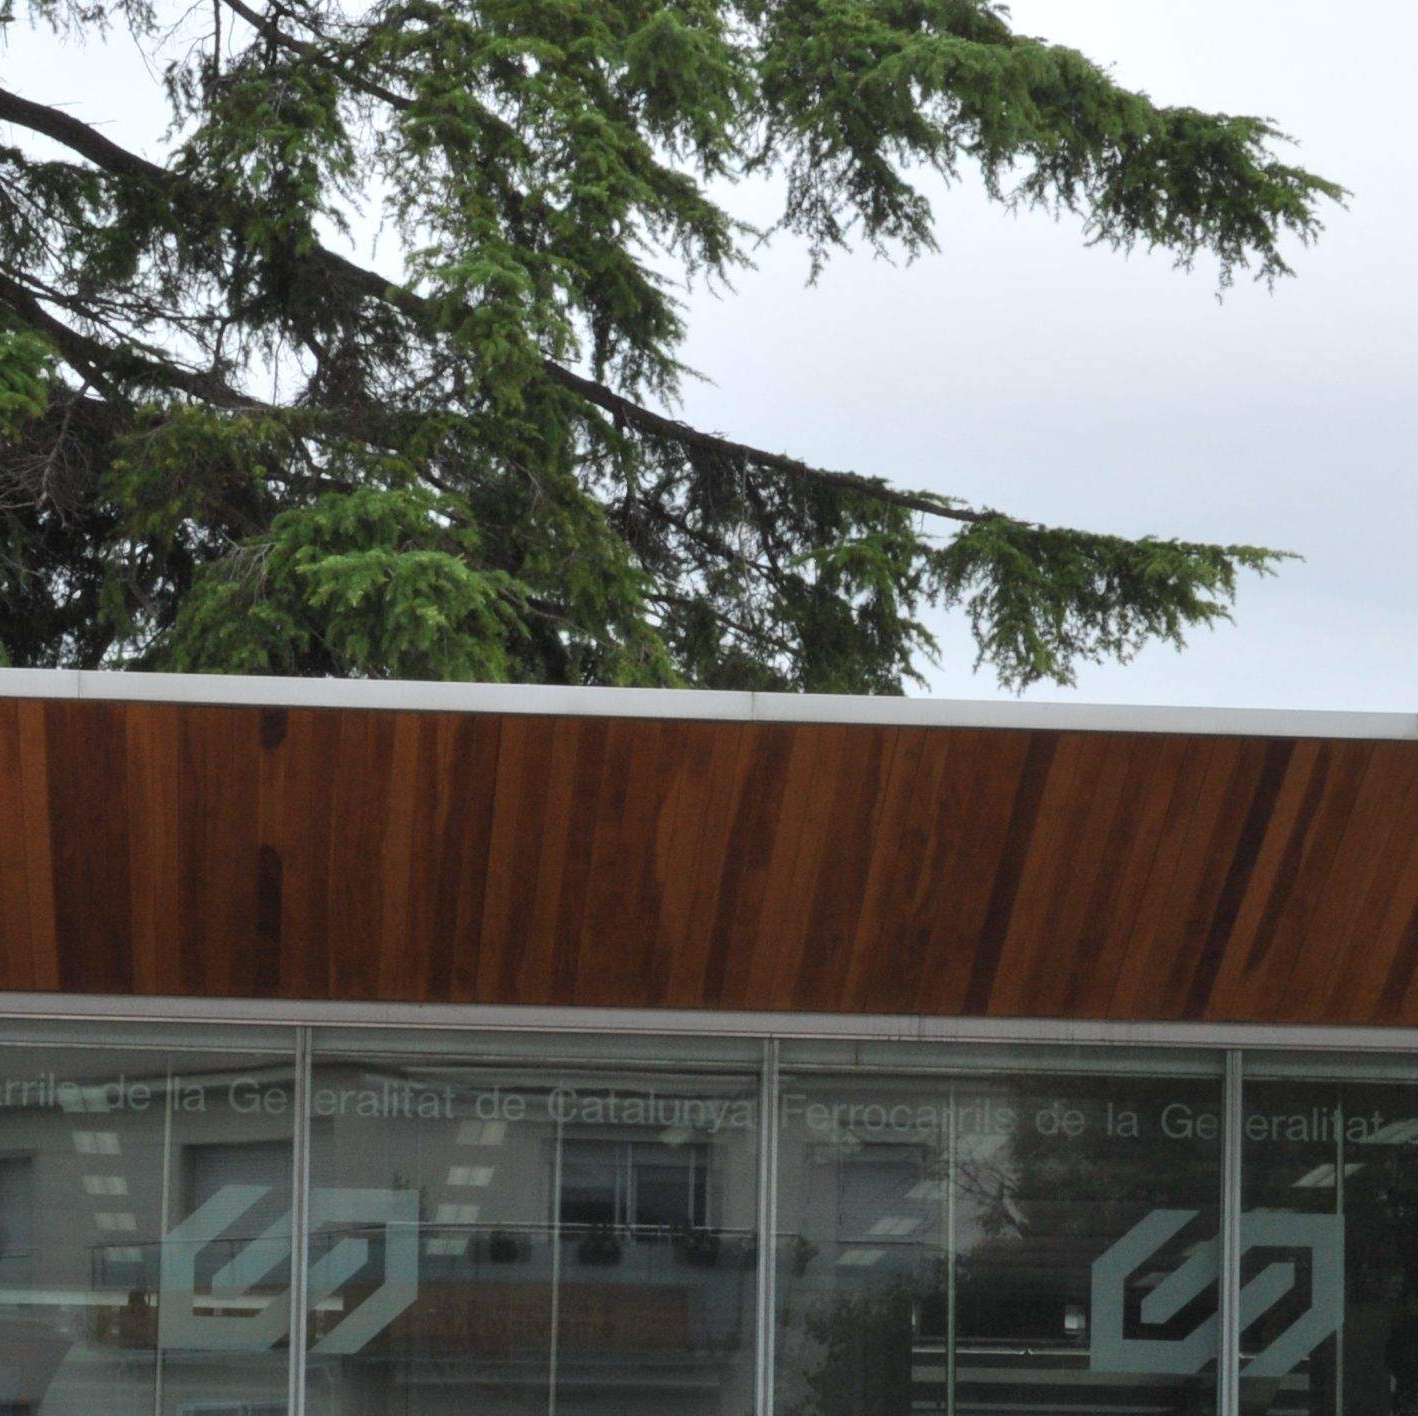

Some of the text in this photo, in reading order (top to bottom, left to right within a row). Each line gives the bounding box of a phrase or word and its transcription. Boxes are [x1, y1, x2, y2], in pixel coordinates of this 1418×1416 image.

[104, 1074, 151, 1111] de
[173, 1076, 207, 1113] la
[228, 1077, 455, 1120] Geeralitat
[476, 1085, 526, 1121] de
[547, 1086, 755, 1133] Catalunya
[782, 1093, 1016, 1136] Ferrocarrils
[1035, 1102, 1086, 1137] de
[1107, 1102, 1139, 1137] la
[1161, 1103, 1384, 1144] Geeralitat
